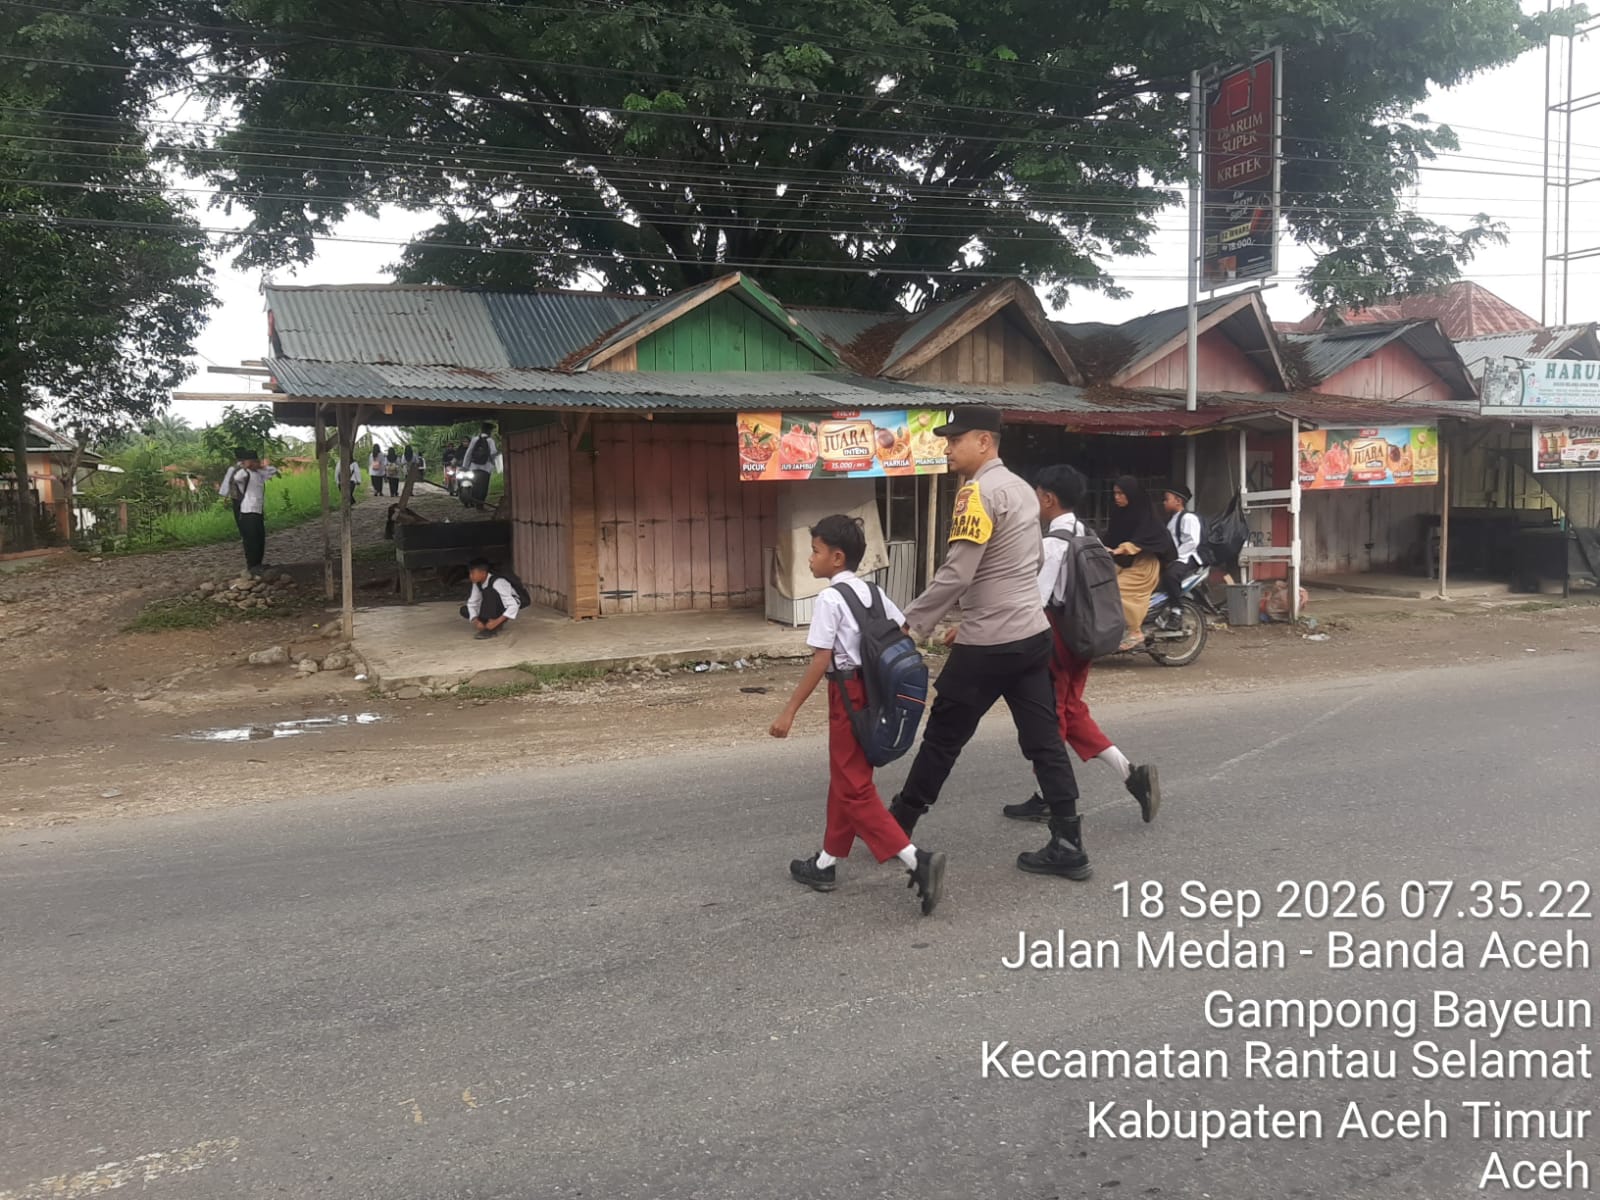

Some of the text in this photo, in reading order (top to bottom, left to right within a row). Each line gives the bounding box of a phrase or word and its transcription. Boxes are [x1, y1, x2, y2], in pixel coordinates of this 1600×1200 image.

[1222, 130, 1257, 154] SUPER
[1217, 157, 1262, 182] KRETEK
[1545, 363, 1600, 379] HARU
[824, 428, 868, 452] JUARA
[1353, 445, 1384, 465] JUARA
[743, 463, 766, 471] PUCUK
